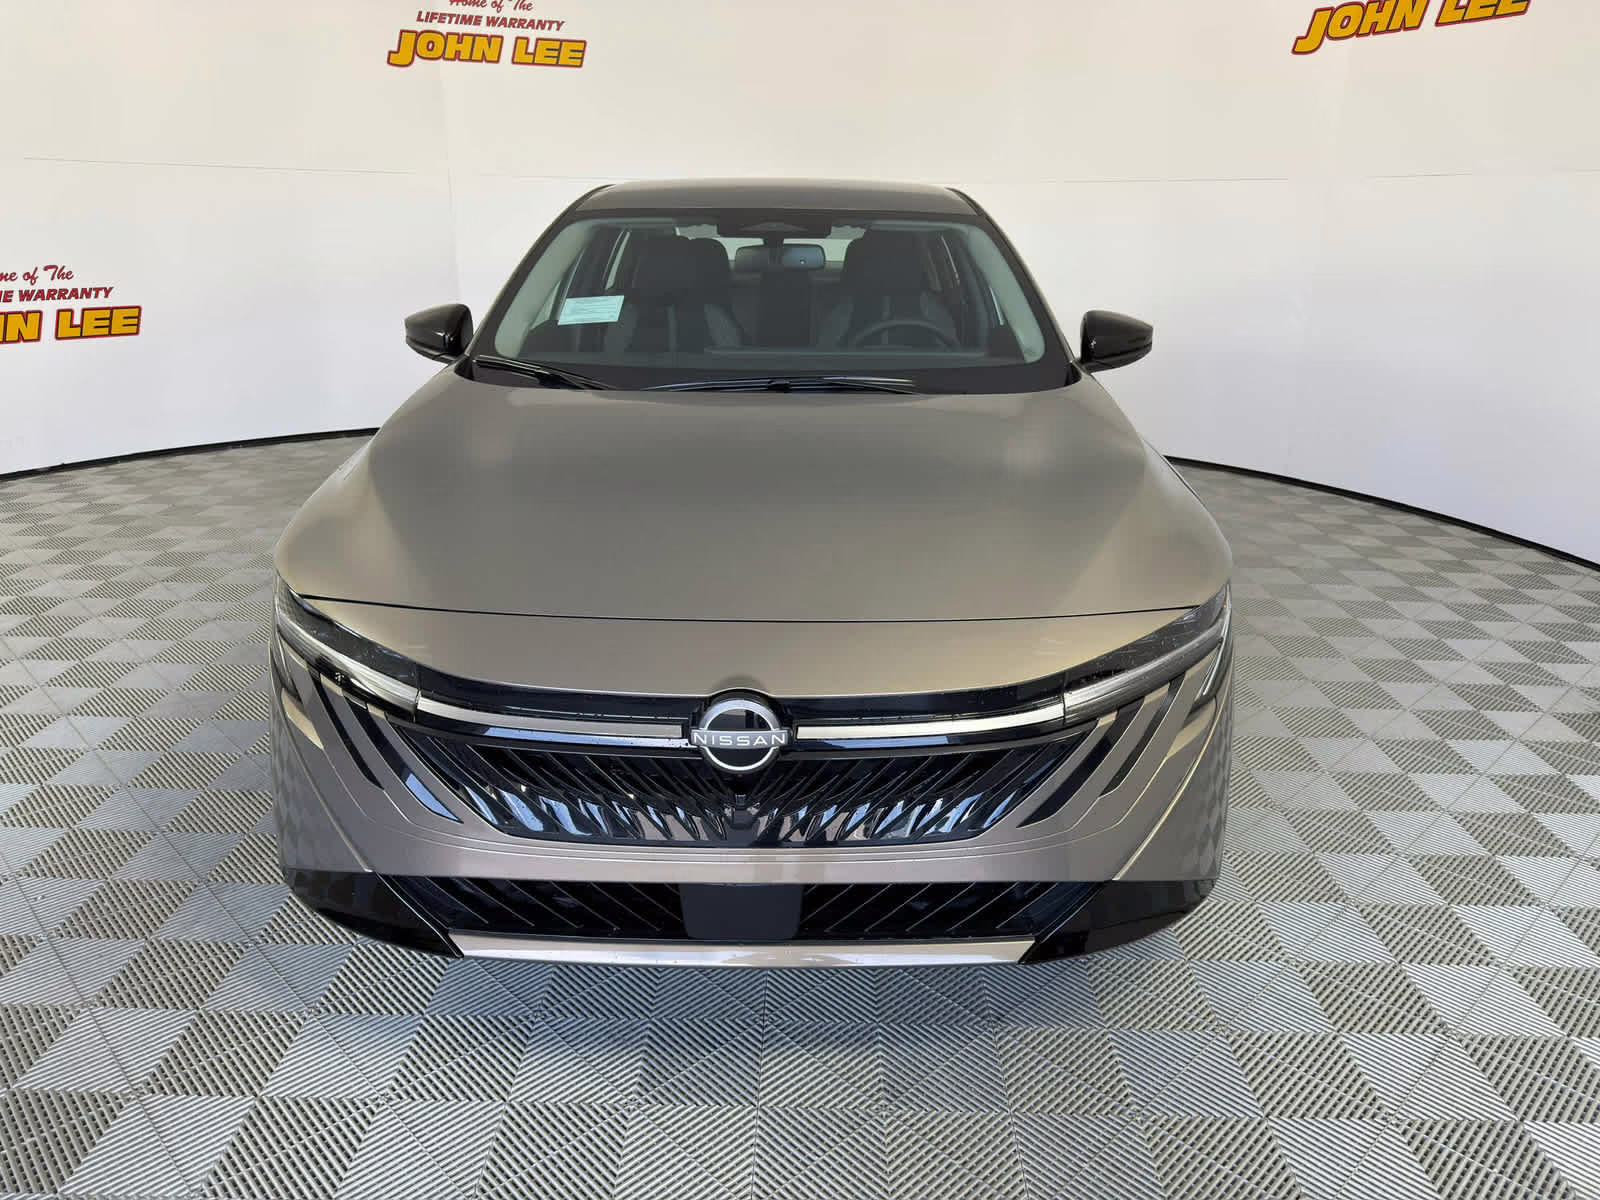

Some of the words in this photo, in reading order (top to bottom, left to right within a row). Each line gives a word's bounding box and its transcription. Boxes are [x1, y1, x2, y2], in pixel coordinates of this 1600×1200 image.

[490, 0, 503, 13] of
[416, 11, 483, 26] LIFETIME
[486, 16, 564, 31] WARRANTY
[1291, 0, 1430, 55] JOHN
[387, 29, 504, 67] JOHN
[511, 36, 587, 68] LEE
[22, 266, 39, 286] of
[43, 265, 74, 281] The
[18, 287, 114, 302] WARRANTY
[55, 305, 142, 341] LEE
[693, 732, 787, 746] NISSAN
